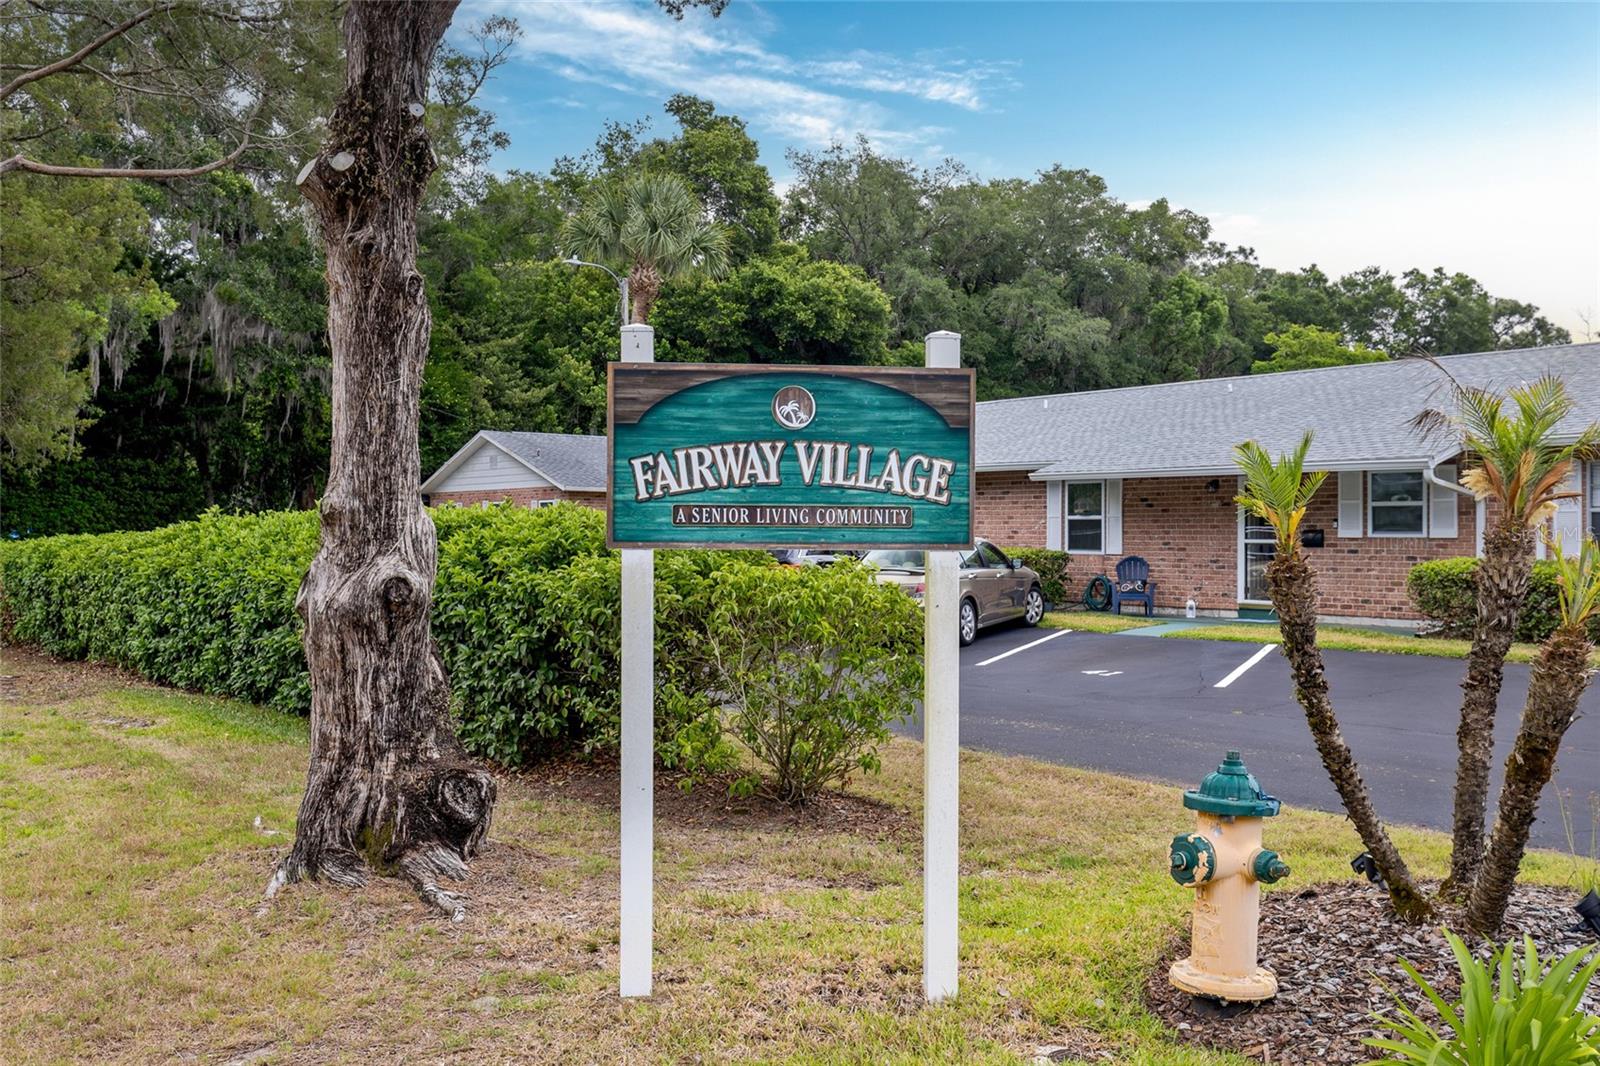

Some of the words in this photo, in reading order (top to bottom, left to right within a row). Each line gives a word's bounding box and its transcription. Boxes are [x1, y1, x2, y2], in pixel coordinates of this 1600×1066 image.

[630, 440, 787, 502] FAIRWAY
[793, 440, 955, 505] VILLAGE
[675, 507, 687, 523] A
[691, 507, 750, 524] SENIOR
[755, 508, 810, 524] LIVING
[816, 508, 910, 525] COMMUNITY
